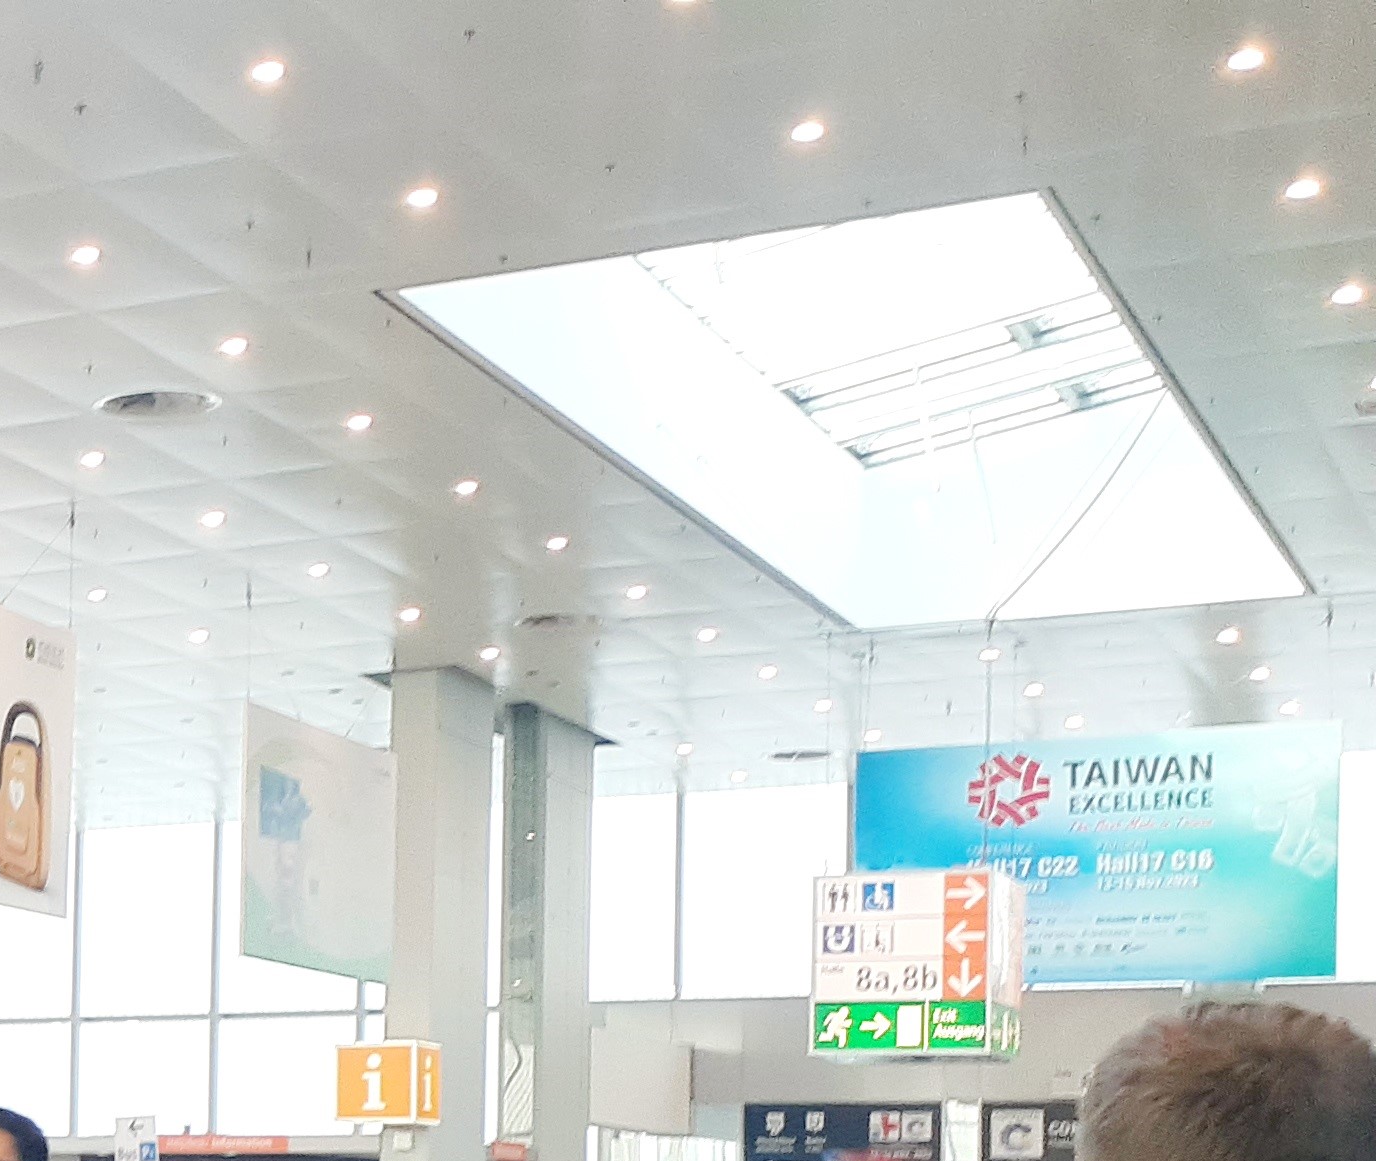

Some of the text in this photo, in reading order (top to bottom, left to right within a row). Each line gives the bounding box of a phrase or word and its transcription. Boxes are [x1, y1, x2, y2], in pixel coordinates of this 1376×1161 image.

[1062, 751, 1215, 790] TAIWAN
[1068, 787, 1214, 816] EXCELLENCE
[1037, 854, 1080, 879] C22
[854, 963, 939, 994] 8a,8b
